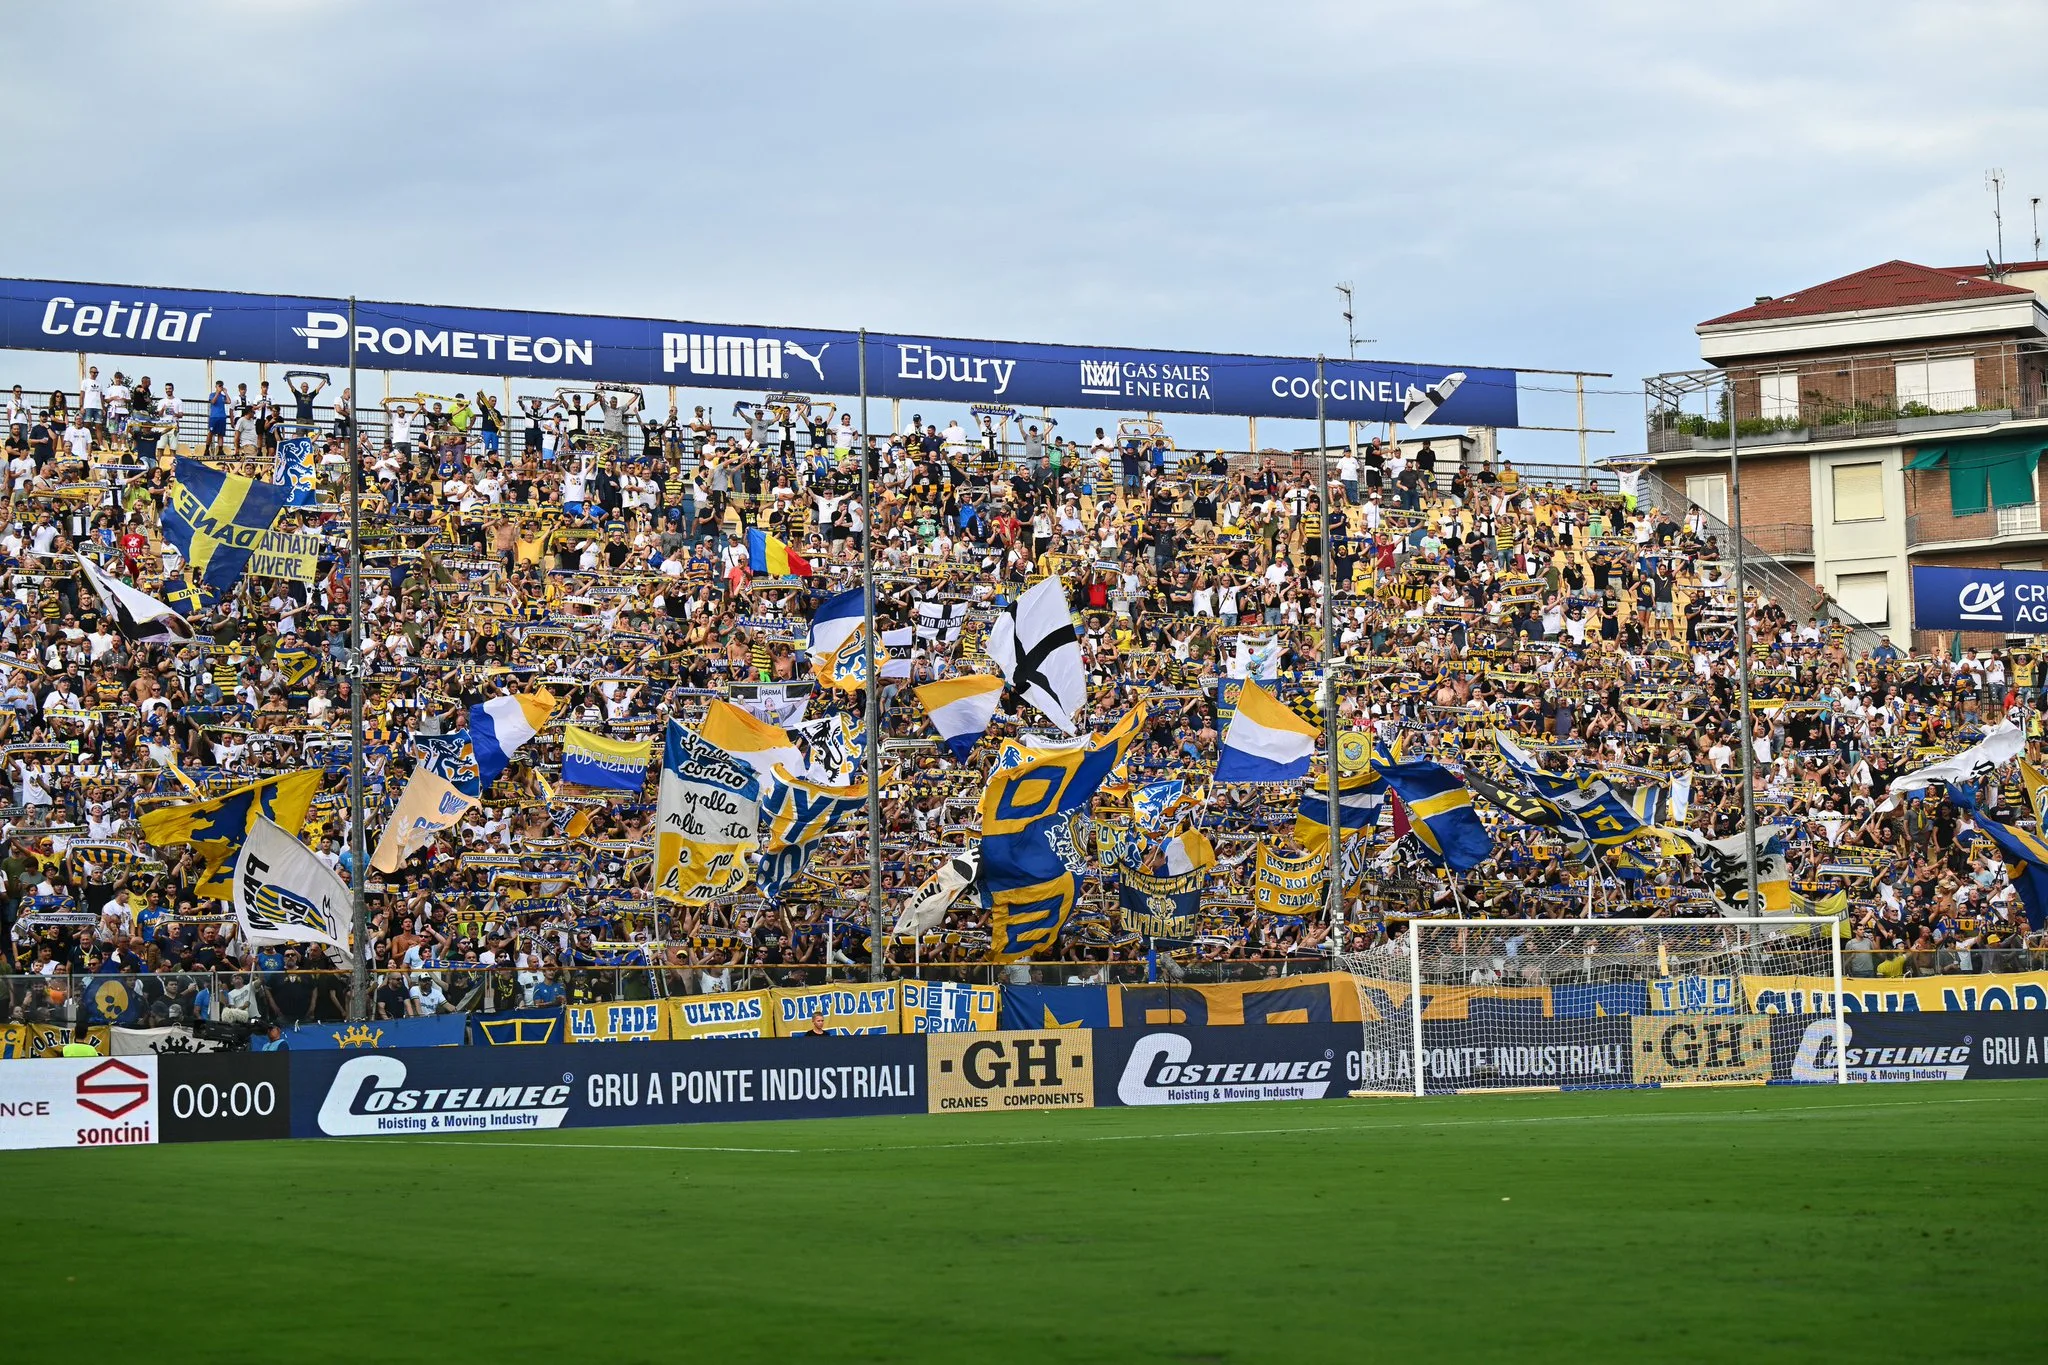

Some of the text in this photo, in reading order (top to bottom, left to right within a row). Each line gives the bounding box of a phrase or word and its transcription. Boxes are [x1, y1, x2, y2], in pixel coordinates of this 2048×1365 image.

[41, 296, 212, 343] Cetilar
[302, 311, 593, 366] PROMETEON
[662, 332, 783, 379] PUMA
[897, 343, 1016, 394] Ebury
[1122, 362, 1210, 382] GAS SALES
[1125, 382, 1211, 400] ENERGIA
[1271, 376, 1440, 403] COCCINEL
[907, 567, 951, 580] BOYS
[2014, 584, 2048, 603] CR
[921, 616, 935, 628] VIA
[681, 761, 748, 789] contro
[1266, 854, 1322, 872] RISPETTO
[1838, 856, 1891, 866] BOYS
[1260, 869, 1308, 889] PER NOI
[1258, 888, 1314, 906] CI SIAMO
[447, 912, 506, 923] BOYS
[684, 1000, 762, 1026] ULTRAS
[782, 986, 897, 1022] DIFFIDATI
[571, 1007, 658, 1035] LA FEDE
[962, 1038, 1063, 1090] GH
[1346, 1050, 1391, 1081] GRU
[1494, 1045, 1621, 1077] INDUSTRIALI
[1982, 1037, 2020, 1066] GRU
[2026, 1036, 2039, 1064] A
[1118, 1033, 1332, 1106] COSTELMEC
[1833, 1069, 1948, 1082] Hsting & Moving Industry
[318, 1055, 571, 1136] COSTELMEC
[588, 1064, 916, 1108] GRU A PONTE INDUSTRIALI
[1167, 1085, 1305, 1102] Hoisting & Moving Industry
[172, 1081, 276, 1119] 00:00
[941, 1093, 1085, 1109] CRANES COMPONENTS
[76, 1120, 150, 1145] soncini
[378, 1111, 539, 1131] Hoisting & Moving Industry
